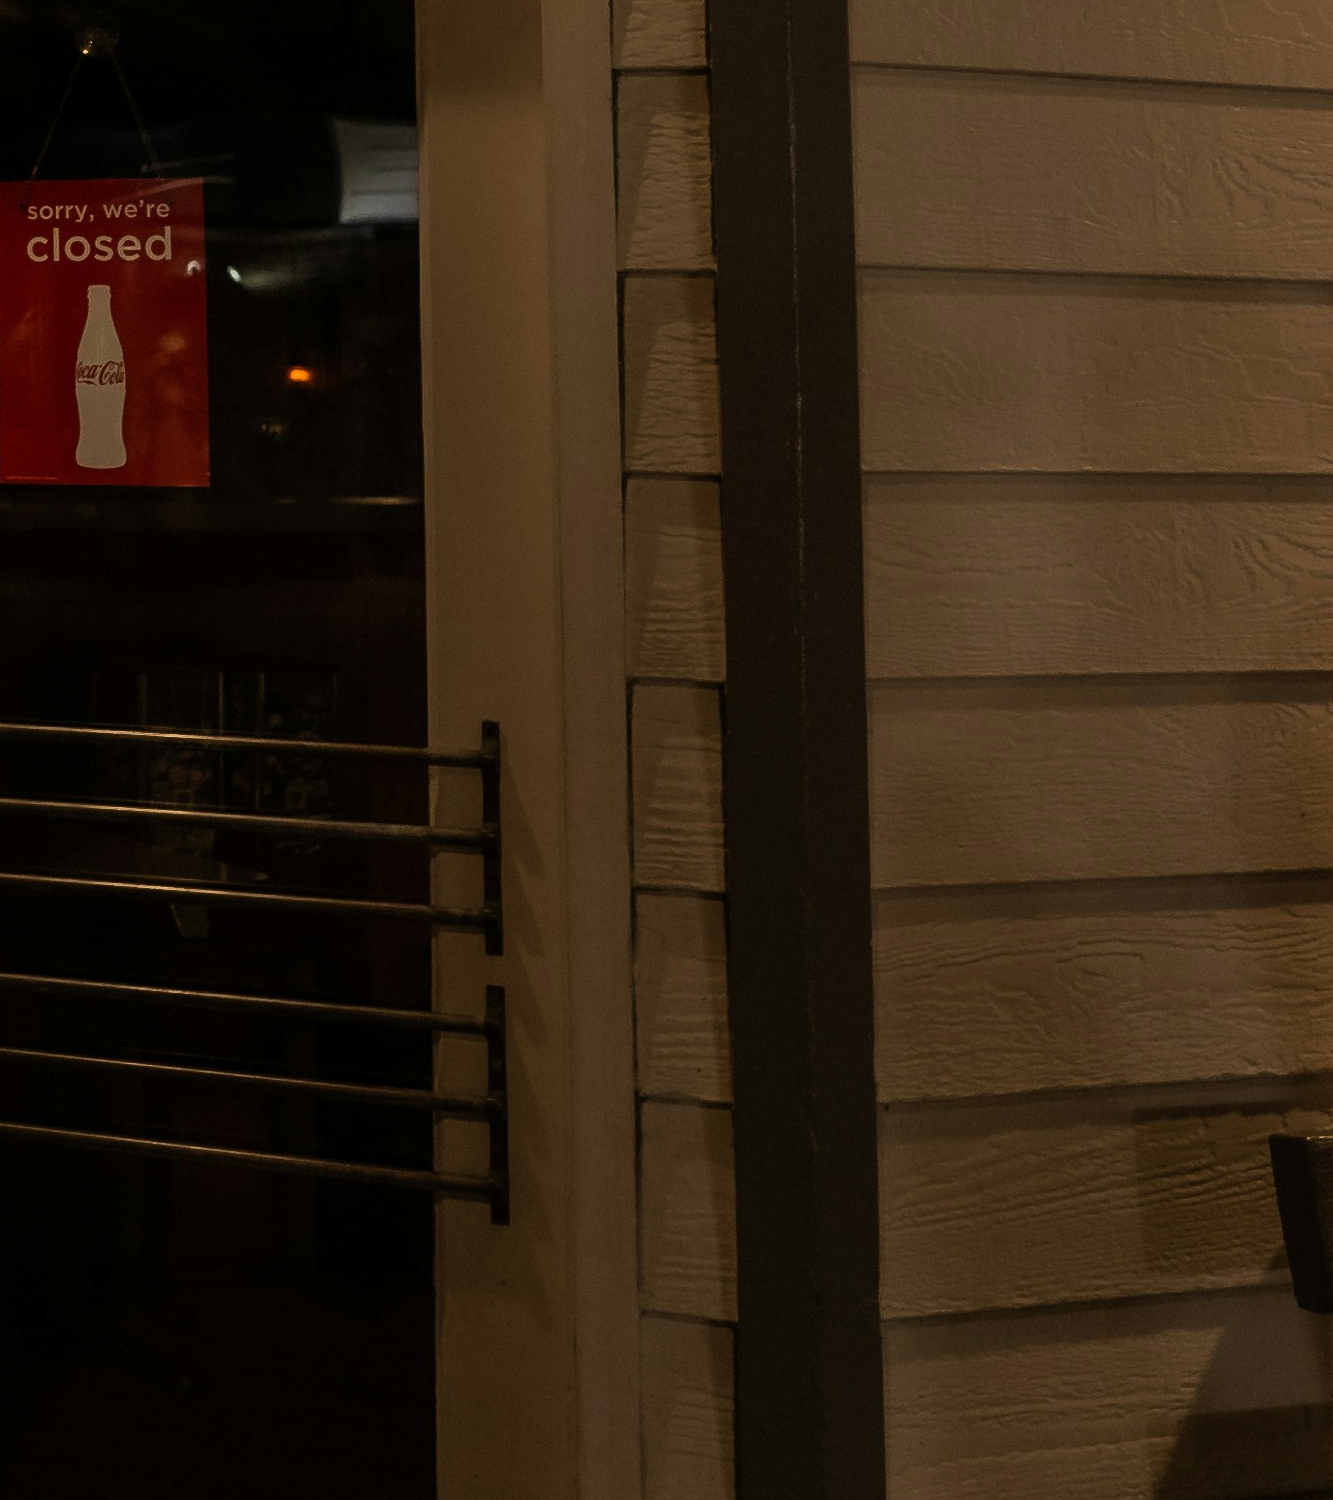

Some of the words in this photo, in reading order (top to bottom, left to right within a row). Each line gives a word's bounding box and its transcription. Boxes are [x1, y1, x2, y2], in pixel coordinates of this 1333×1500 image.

[27, 203, 95, 223] sorry,
[103, 200, 170, 218] we're
[26, 226, 173, 262] closed
